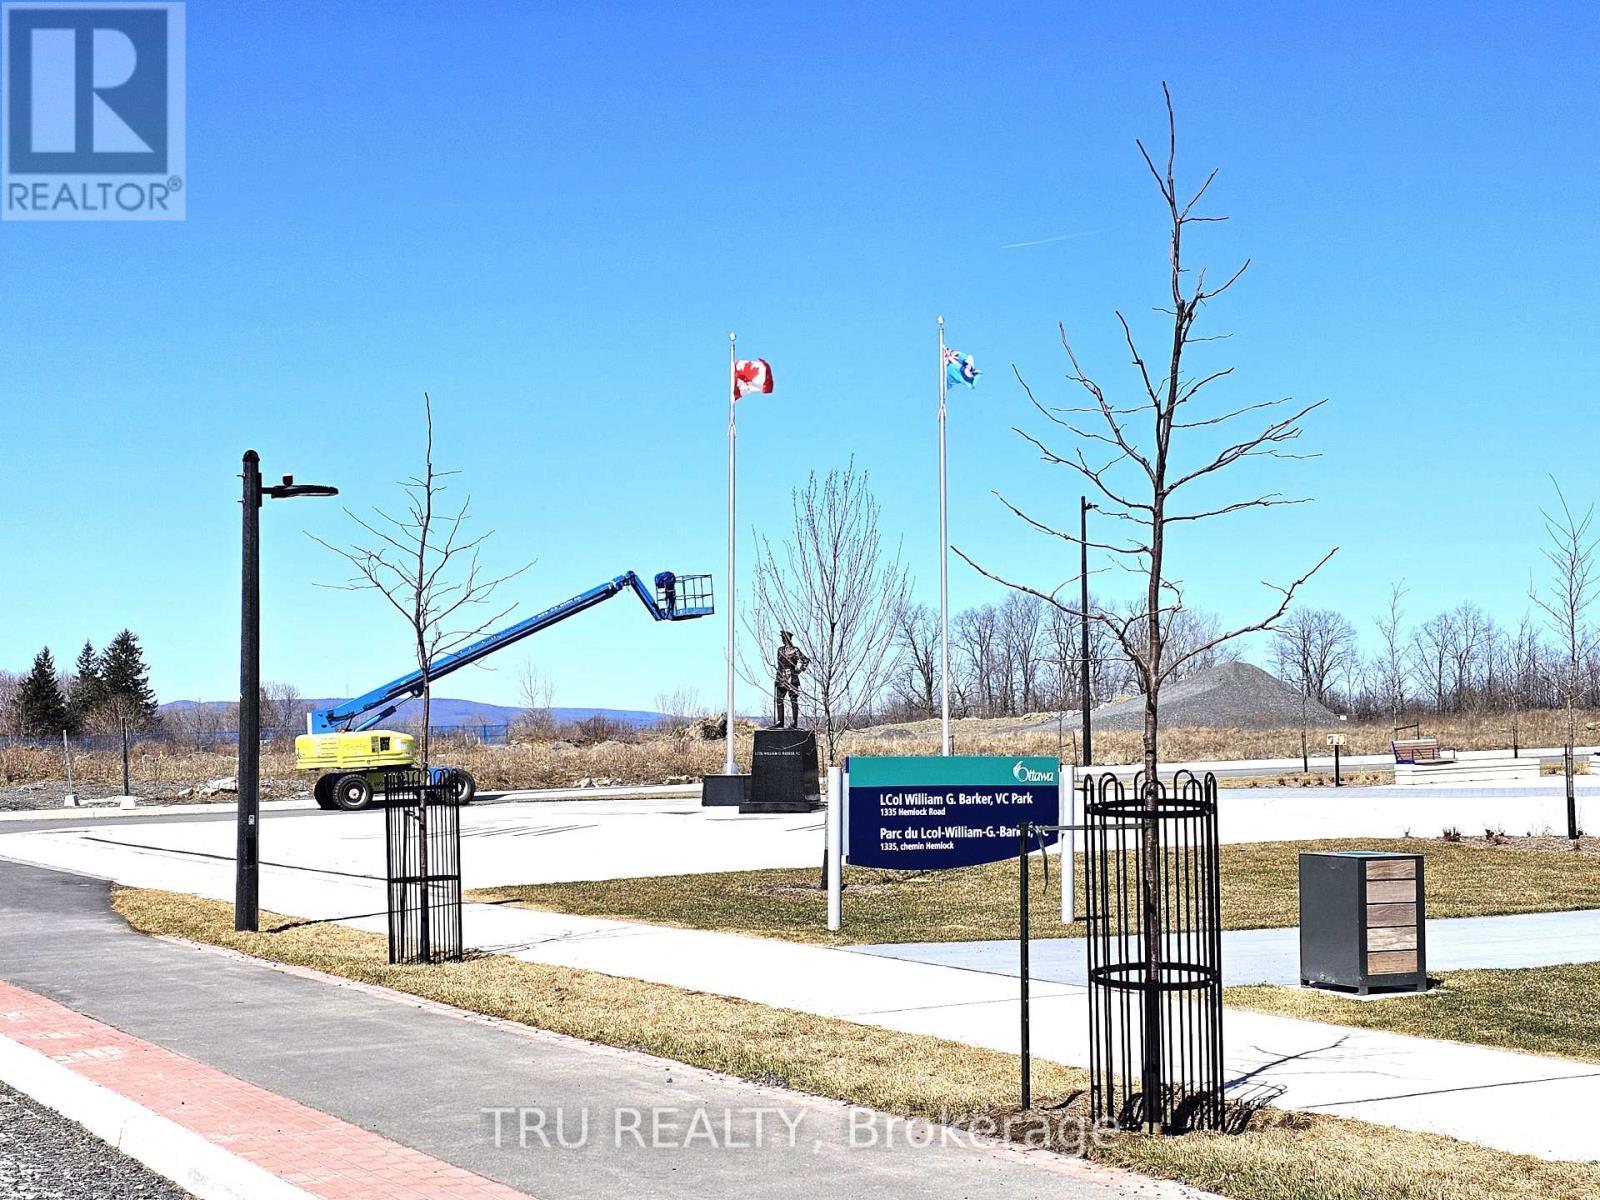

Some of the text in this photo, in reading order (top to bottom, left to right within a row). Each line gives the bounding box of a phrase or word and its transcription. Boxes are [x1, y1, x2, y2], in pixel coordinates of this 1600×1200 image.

[1012, 760, 1054, 782] Ottawa
[880, 791, 1033, 806] LCol William G. Barker, VC Park
[880, 806, 946, 816] 1335 Hemlock Road
[880, 827, 903, 839] Parc
[904, 826, 918, 839] du
[880, 841, 954, 851] 1335, chemin Hemlock
